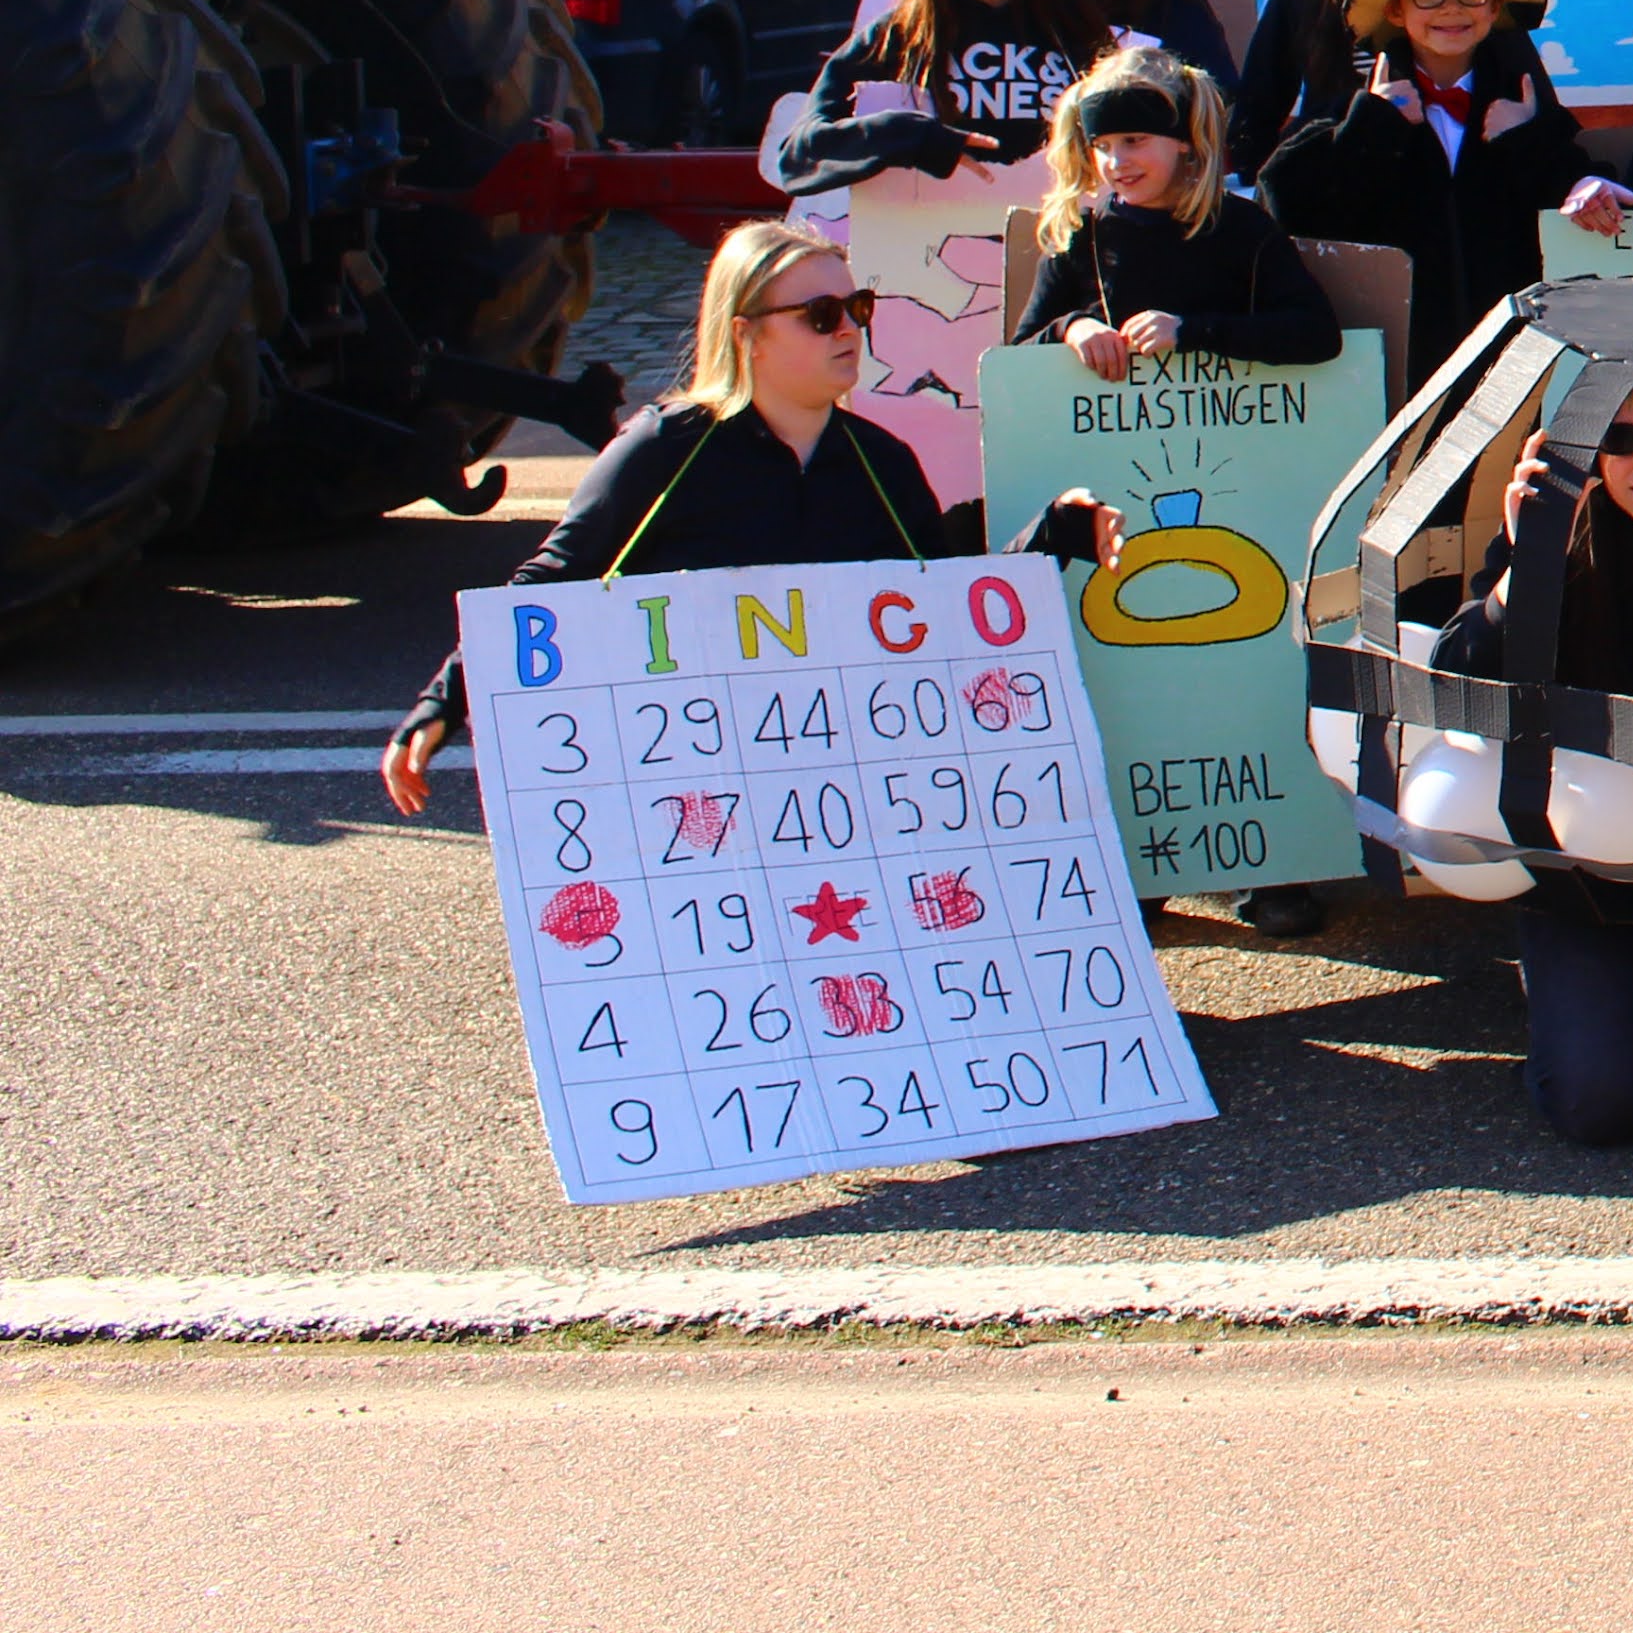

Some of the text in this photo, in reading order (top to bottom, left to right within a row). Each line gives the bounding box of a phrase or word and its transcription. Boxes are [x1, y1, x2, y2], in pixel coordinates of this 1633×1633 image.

[537, 670, 1054, 774] 3 29 44 60 69
[555, 761, 1068, 873] 8 27 40 59 61
[1128, 752, 1285, 817] BETAAL
[671, 892, 751, 956] 19
[1009, 856, 1096, 920] 74
[578, 947, 1125, 1058] 4 26 33 54 70
[610, 1035, 1160, 1165] 9 17 34 50 71
